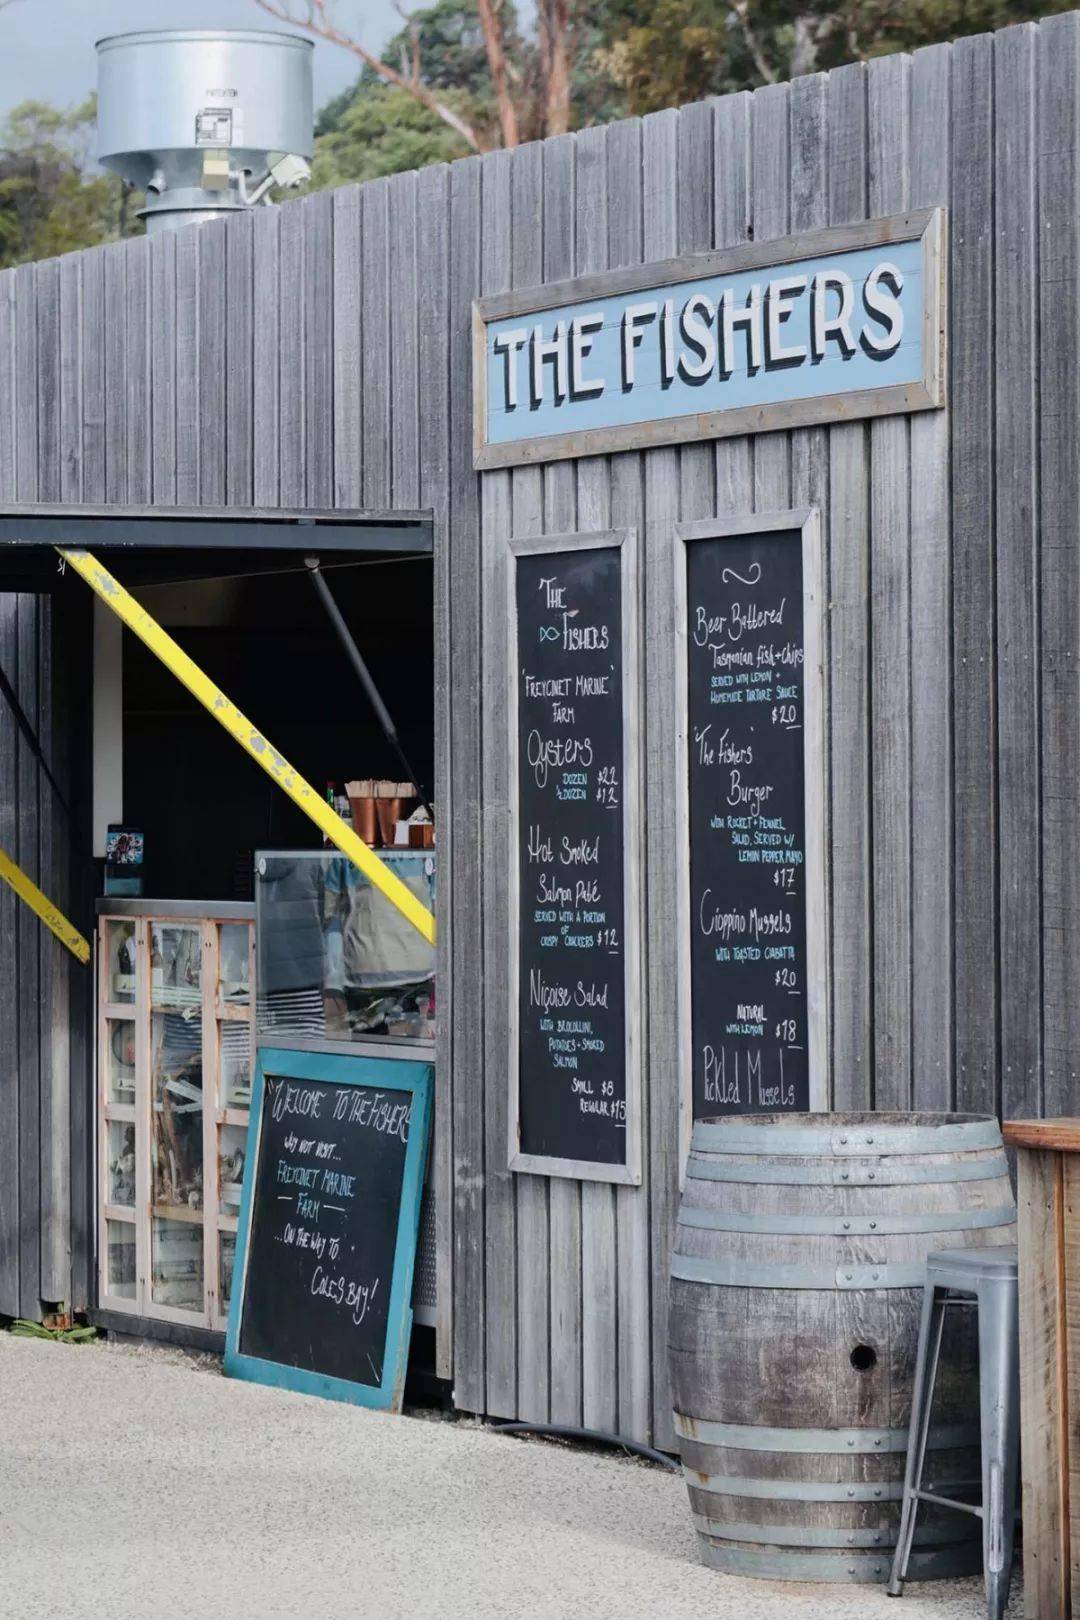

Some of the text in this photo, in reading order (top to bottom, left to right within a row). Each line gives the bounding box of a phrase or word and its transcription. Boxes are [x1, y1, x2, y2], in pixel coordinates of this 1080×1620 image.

[493, 262, 905, 413] THE FISHERS
[538, 577, 567, 608] THE
[693, 597, 786, 647] Beer Battered
[708, 643, 754, 671] Tasmanian
[552, 702, 575, 723] FARM
[771, 704, 797, 724] $20
[527, 729, 593, 788] Oysters
[597, 766, 619, 785] $22
[596, 787, 619, 803] $12
[727, 769, 774, 817] Burger
[527, 824, 555, 864] Hot
[536, 873, 573, 908] Salmon
[773, 867, 796, 888] $17
[700, 888, 793, 943] Cioppino Mussels
[597, 928, 619, 946] $12
[774, 967, 797, 987] $20
[574, 981, 608, 1009] Salad
[775, 1019, 797, 1042] $18
[571, 1077, 614, 1096] SMALL $8
[747, 1048, 796, 1106] Mussels
[333, 1088, 352, 1121] TO
[348, 1090, 372, 1127] THE
[320, 1168, 357, 1198] MARINE
[296, 1192, 321, 1223] FARM
[328, 1237, 341, 1261] TO
[311, 1265, 345, 1304] COLES
